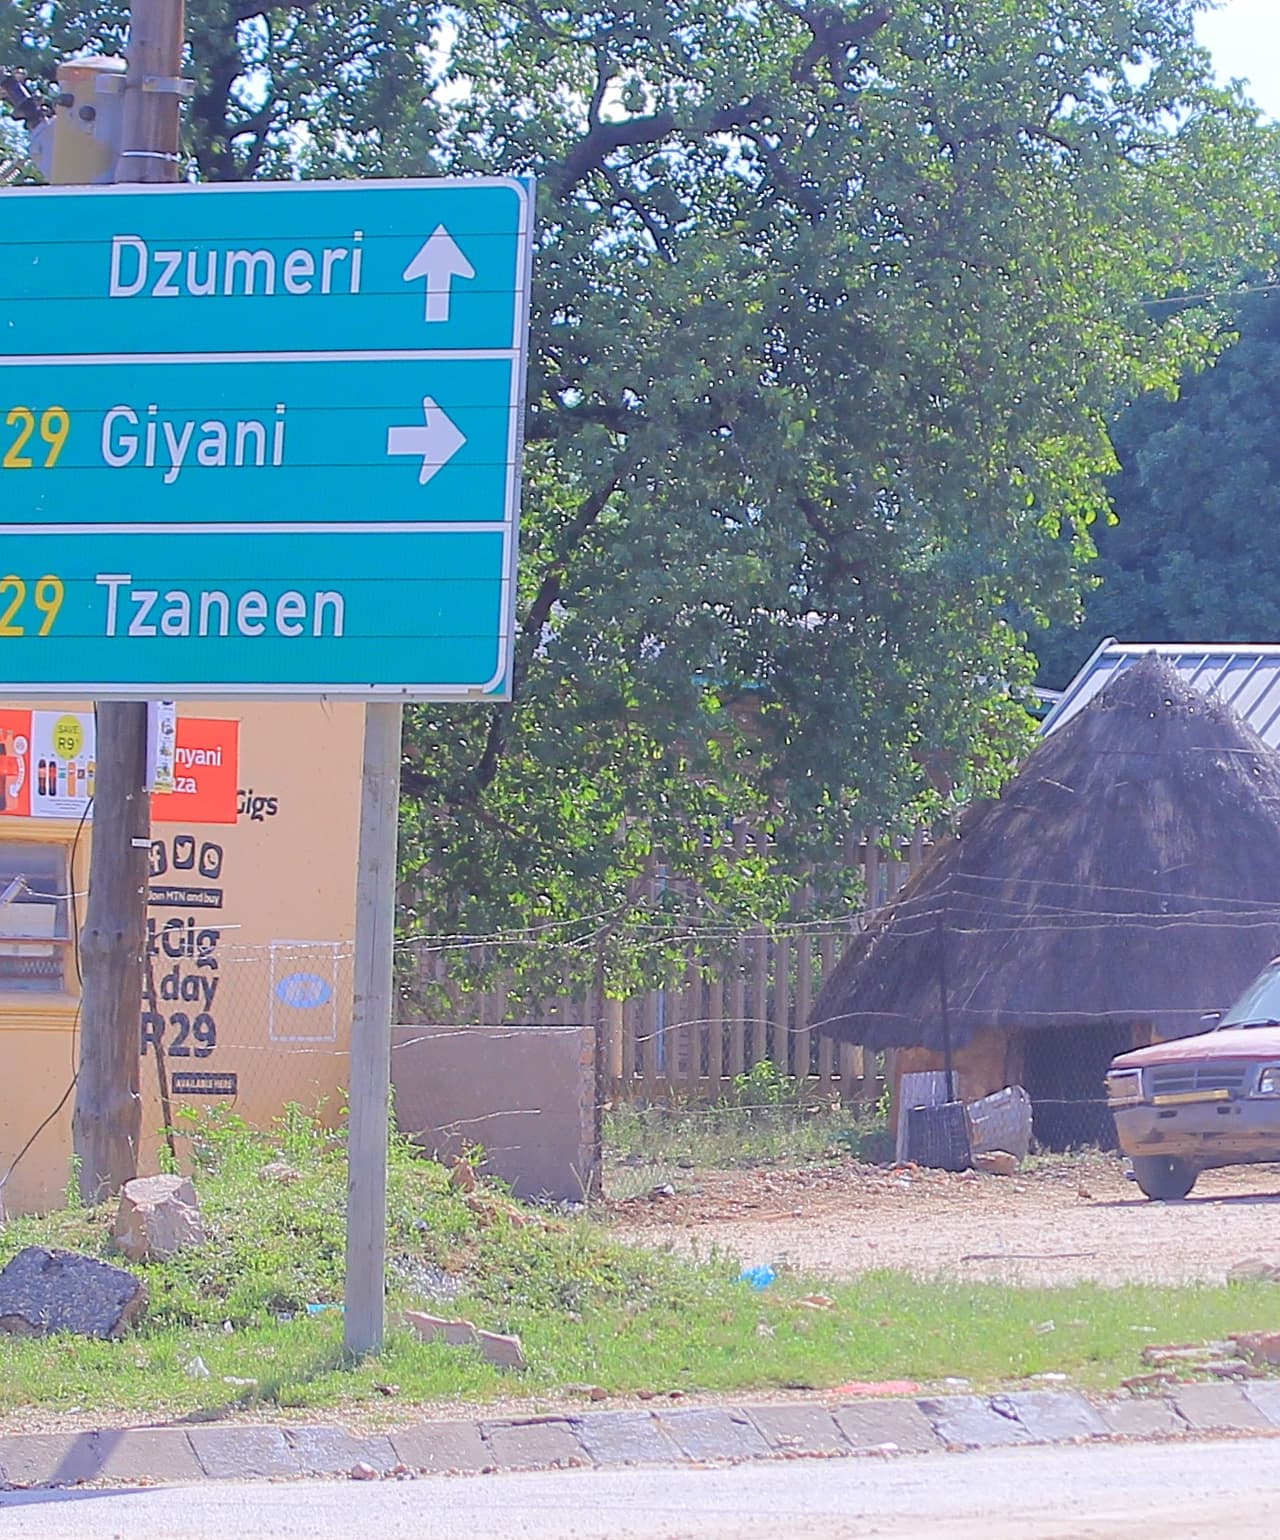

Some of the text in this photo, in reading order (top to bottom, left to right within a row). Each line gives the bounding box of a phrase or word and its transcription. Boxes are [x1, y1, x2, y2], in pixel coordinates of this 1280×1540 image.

[108, 231, 365, 298] Dzumeri
[100, 402, 287, 484] Giyani
[95, 571, 346, 638] Tzaneen
[58, 725, 79, 734] SAVE
[166, 890, 186, 902] MTN
[187, 892, 203, 903] and
[204, 892, 220, 906] buy
[160, 964, 219, 1012] day
[140, 1011, 217, 1058] R29
[176, 1079, 213, 1089] AVAILABLE
